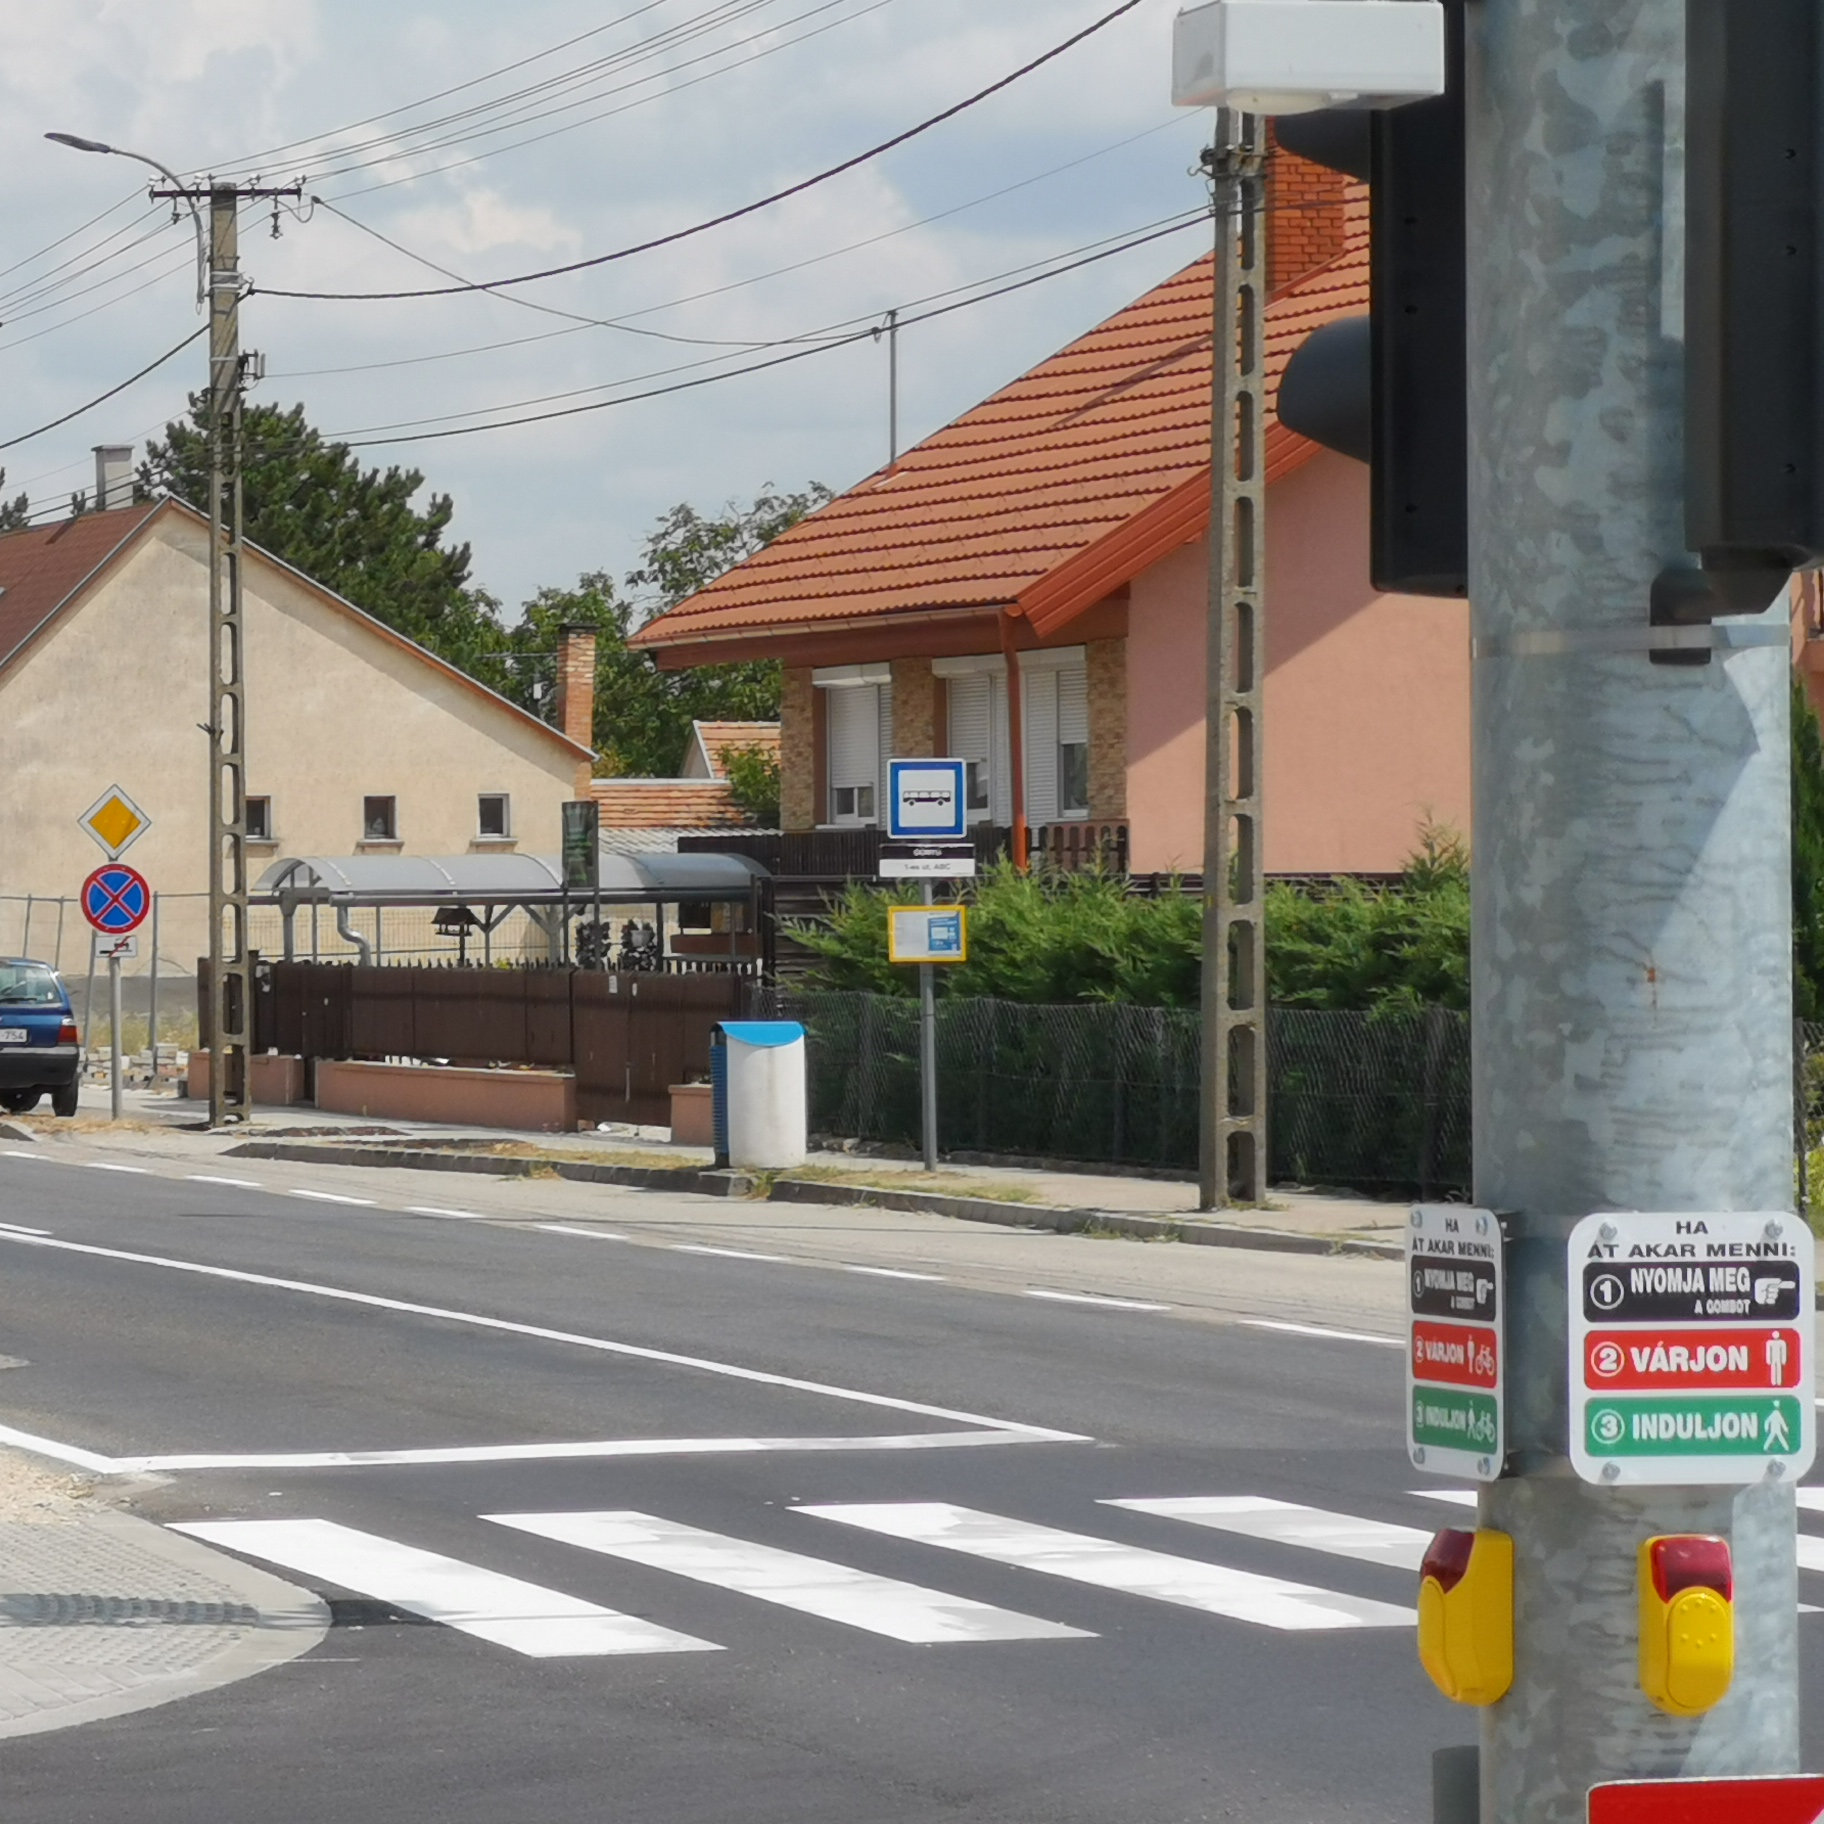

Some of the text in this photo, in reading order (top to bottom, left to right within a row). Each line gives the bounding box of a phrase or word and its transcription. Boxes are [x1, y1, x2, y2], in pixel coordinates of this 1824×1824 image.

[1444, 1217, 1460, 1233] HA
[1675, 1220, 1709, 1235] HA
[1427, 1238, 1456, 1256] AKAR
[1628, 1243, 1696, 1258] AKAR
[1705, 1242, 1796, 1258] MENNI:
[1630, 1267, 1706, 1295] NYOMJA
[1708, 1266, 1751, 1294] MEG
[1693, 1299, 1704, 1315] A
[1629, 1340, 1749, 1373] VÁRJON
[1632, 1411, 1759, 1440] INDULJON
